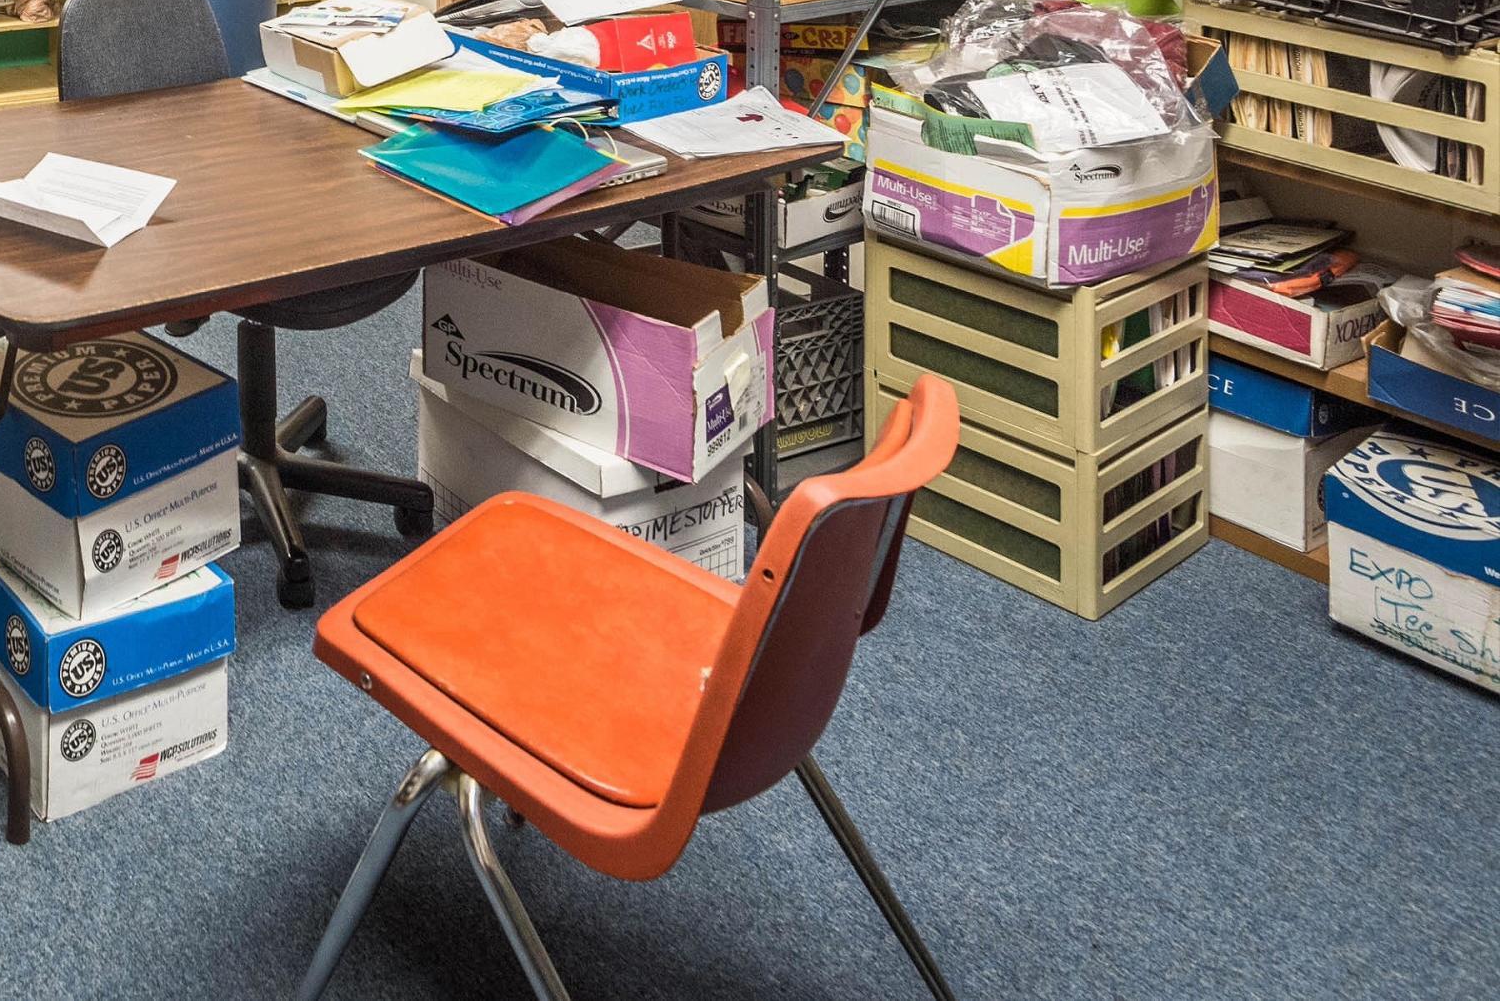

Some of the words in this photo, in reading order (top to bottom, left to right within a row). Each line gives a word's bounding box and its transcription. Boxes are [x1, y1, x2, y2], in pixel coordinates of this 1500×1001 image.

[878, 175, 932, 205] Multi-Use
[1074, 171, 1115, 183] Spectrum
[1068, 236, 1144, 265] Multi-Use
[438, 320, 457, 335] GP
[23, 346, 96, 401] PREMIUM
[57, 358, 125, 395] US
[102, 358, 161, 410] PAPER
[445, 341, 577, 416] Spectrum
[32, 458, 48, 473] US
[97, 458, 117, 483] US
[101, 542, 116, 560] US
[1350, 547, 1433, 600] EXPO
[1380, 596, 1438, 640] Tee
[12, 636, 24, 655] US
[71, 654, 95, 681] US
[70, 731, 89, 749] US
[160, 729, 218, 762] WCPSOLUTIONS
